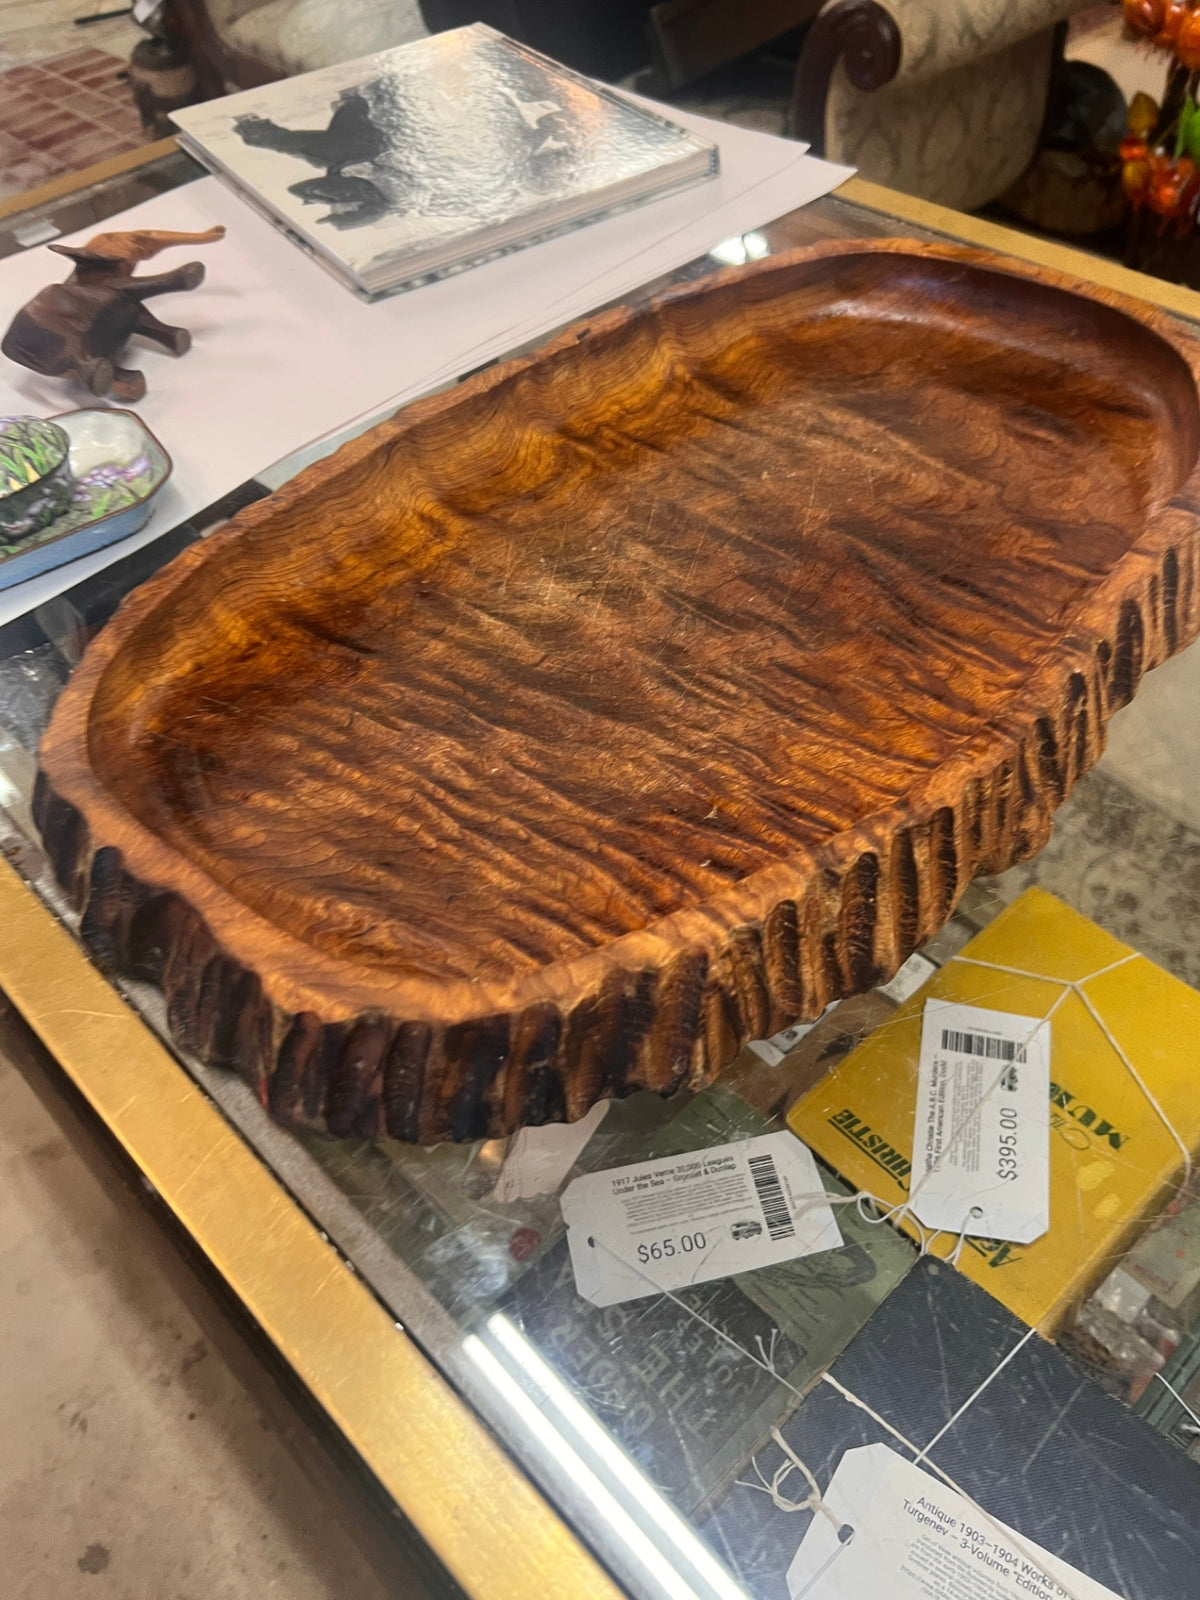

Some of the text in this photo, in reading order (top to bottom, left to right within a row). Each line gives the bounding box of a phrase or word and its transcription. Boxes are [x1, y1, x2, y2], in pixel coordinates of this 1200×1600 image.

[931, 1061, 939, 1087] Murders
[928, 1110, 936, 1123] The
[936, 1104, 944, 1136] American
[926, 1125, 934, 1151] Christie
[997, 1107, 1018, 1181] $395.00
[612, 1176, 630, 1187] 1917
[633, 1173, 652, 1183] Jules
[653, 1168, 675, 1178] Verne
[703, 1156, 734, 1168] Leagues
[612, 1185, 635, 1195] Under
[637, 1182, 648, 1190] the
[650, 1179, 665, 1188] Sea
[703, 1168, 710, 1176] &
[710, 1163, 737, 1175] Dunlap
[637, 1232, 706, 1264] $65.00
[902, 1500, 949, 1536] Turgenev
[959, 1541, 1010, 1577] 3-Volume
[917, 1496, 957, 1528] Antique
[1021, 1561, 1054, 1590] Works
